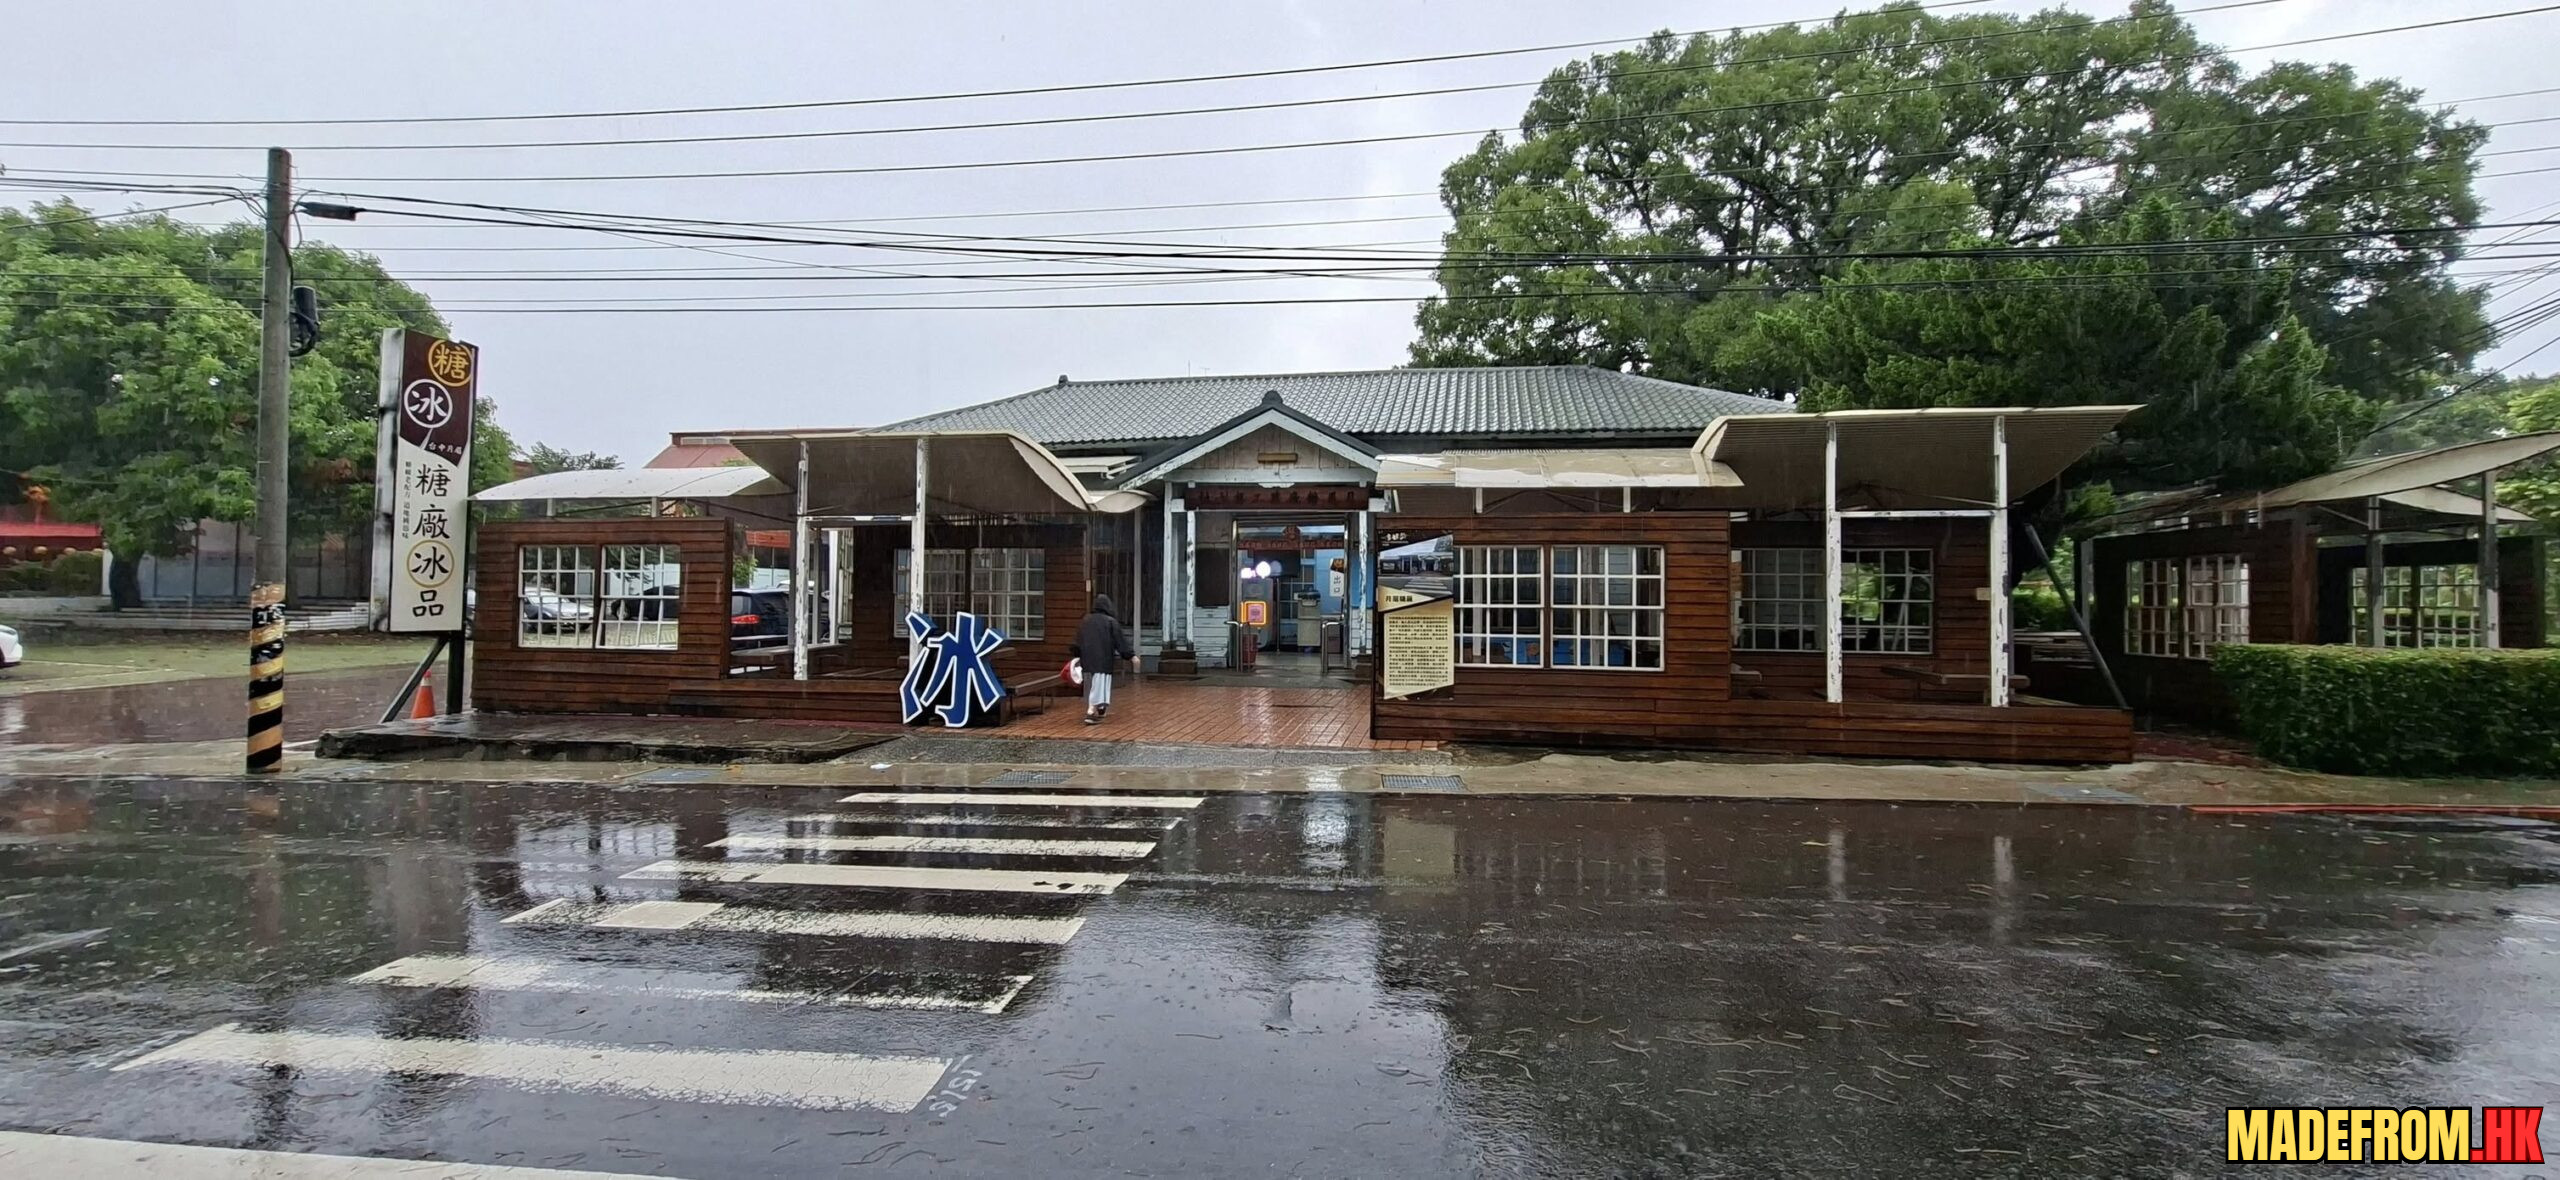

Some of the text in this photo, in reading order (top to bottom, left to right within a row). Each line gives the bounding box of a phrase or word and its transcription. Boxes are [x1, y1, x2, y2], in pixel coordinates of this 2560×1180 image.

[433, 343, 470, 380] 糖
[408, 386, 448, 422] 冰
[411, 464, 452, 617] 糖廠冰品
[1333, 575, 1342, 593] 出口
[899, 611, 1006, 728] 冰
